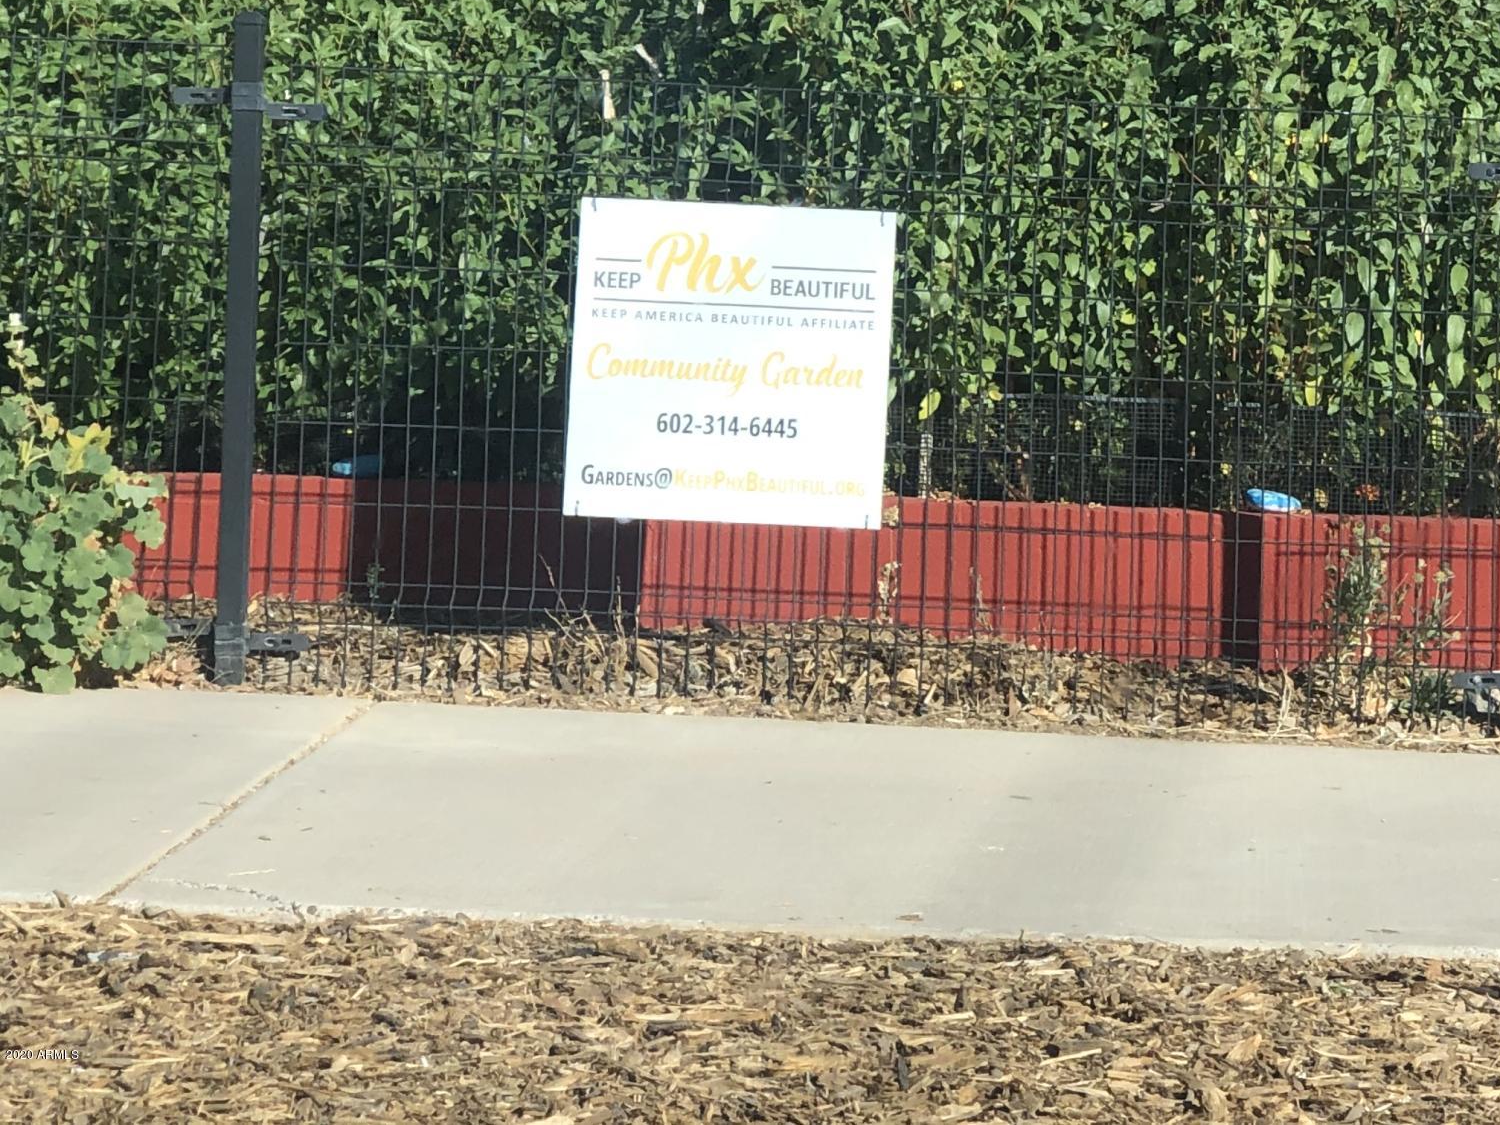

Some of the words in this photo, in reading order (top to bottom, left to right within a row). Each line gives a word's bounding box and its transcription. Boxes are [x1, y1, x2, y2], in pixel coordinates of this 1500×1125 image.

[593, 271, 641, 289] KEEP
[646, 231, 766, 294] Phx
[770, 278, 876, 300] BEAUTIFUL
[592, 308, 627, 319] KEEP
[634, 310, 703, 323] AMERICA
[711, 313, 793, 327] BEAUTIFUL
[800, 317, 875, 330] AFFILIATE
[586, 342, 748, 397] Community
[761, 351, 864, 390] Garden
[656, 412, 798, 439] 602-314-6445
